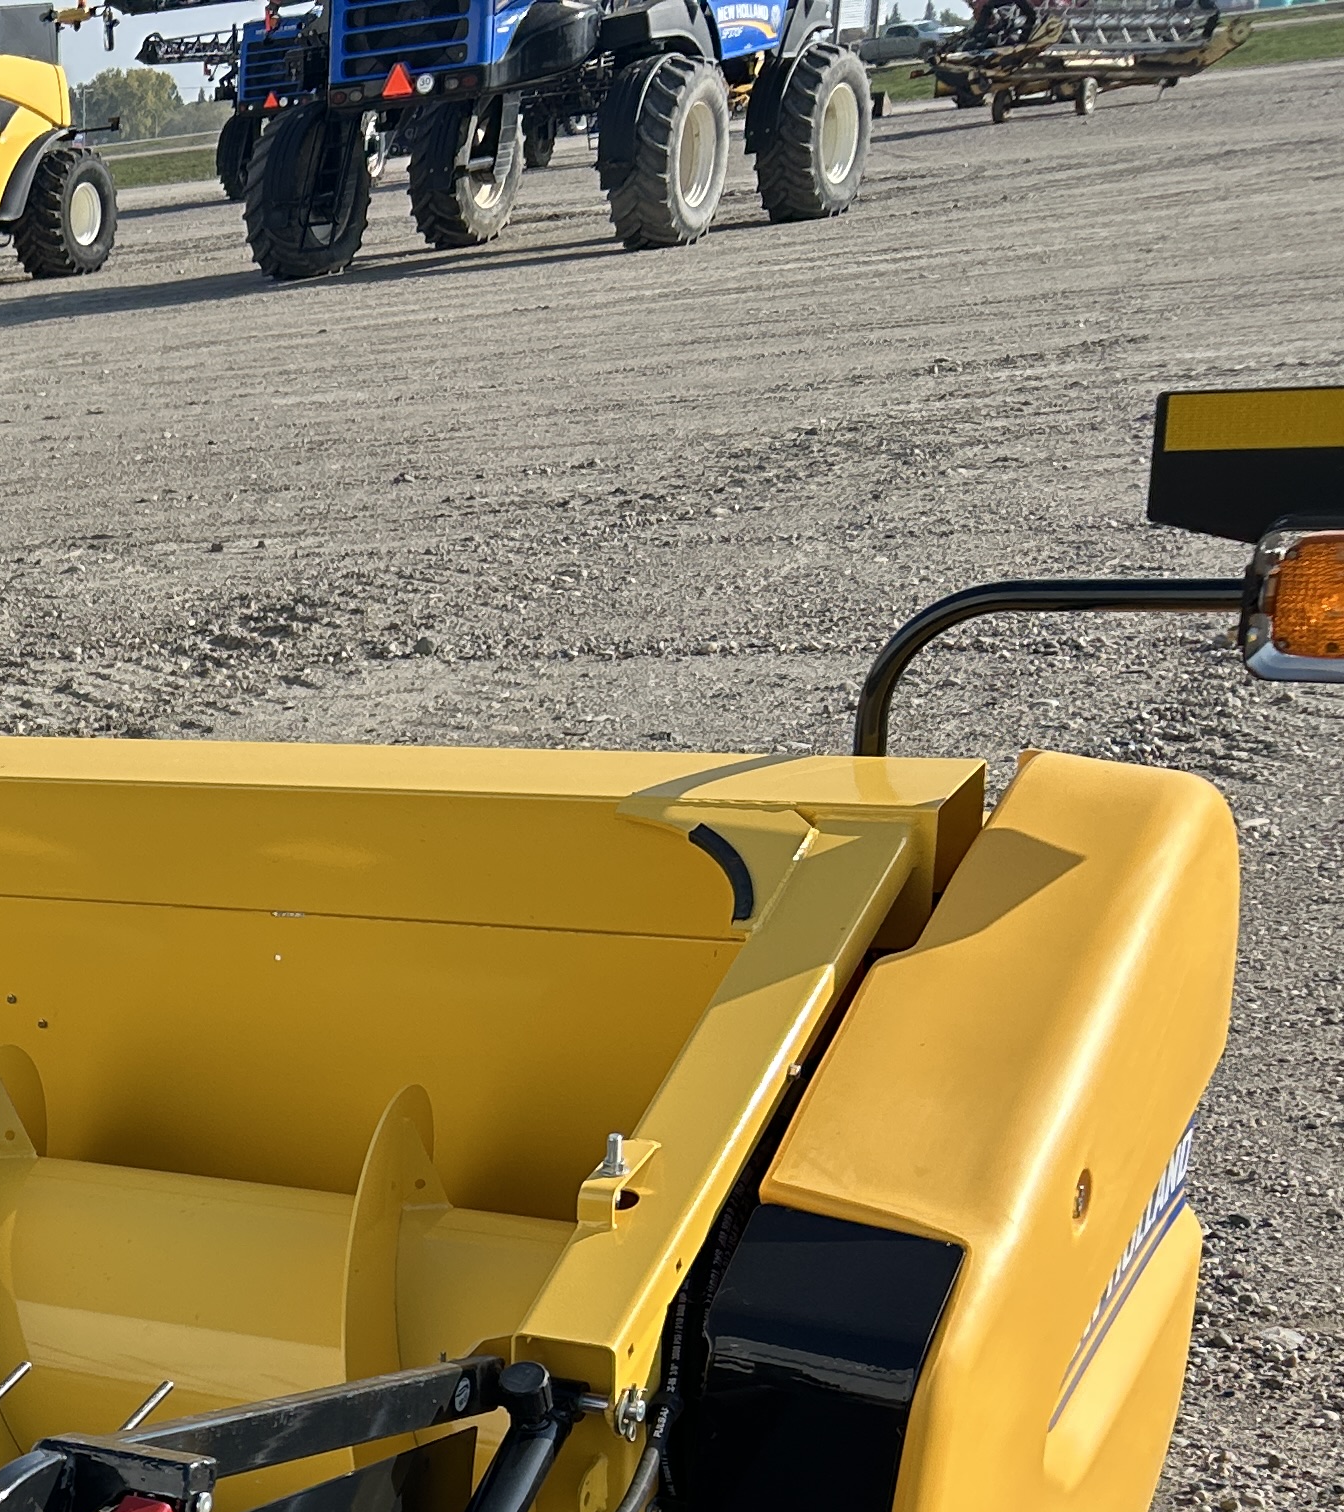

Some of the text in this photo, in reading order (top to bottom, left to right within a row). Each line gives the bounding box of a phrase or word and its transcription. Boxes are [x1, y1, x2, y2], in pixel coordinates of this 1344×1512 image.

[716, 3, 769, 22] NEW HOLLAND
[419, 77, 431, 87] 30
